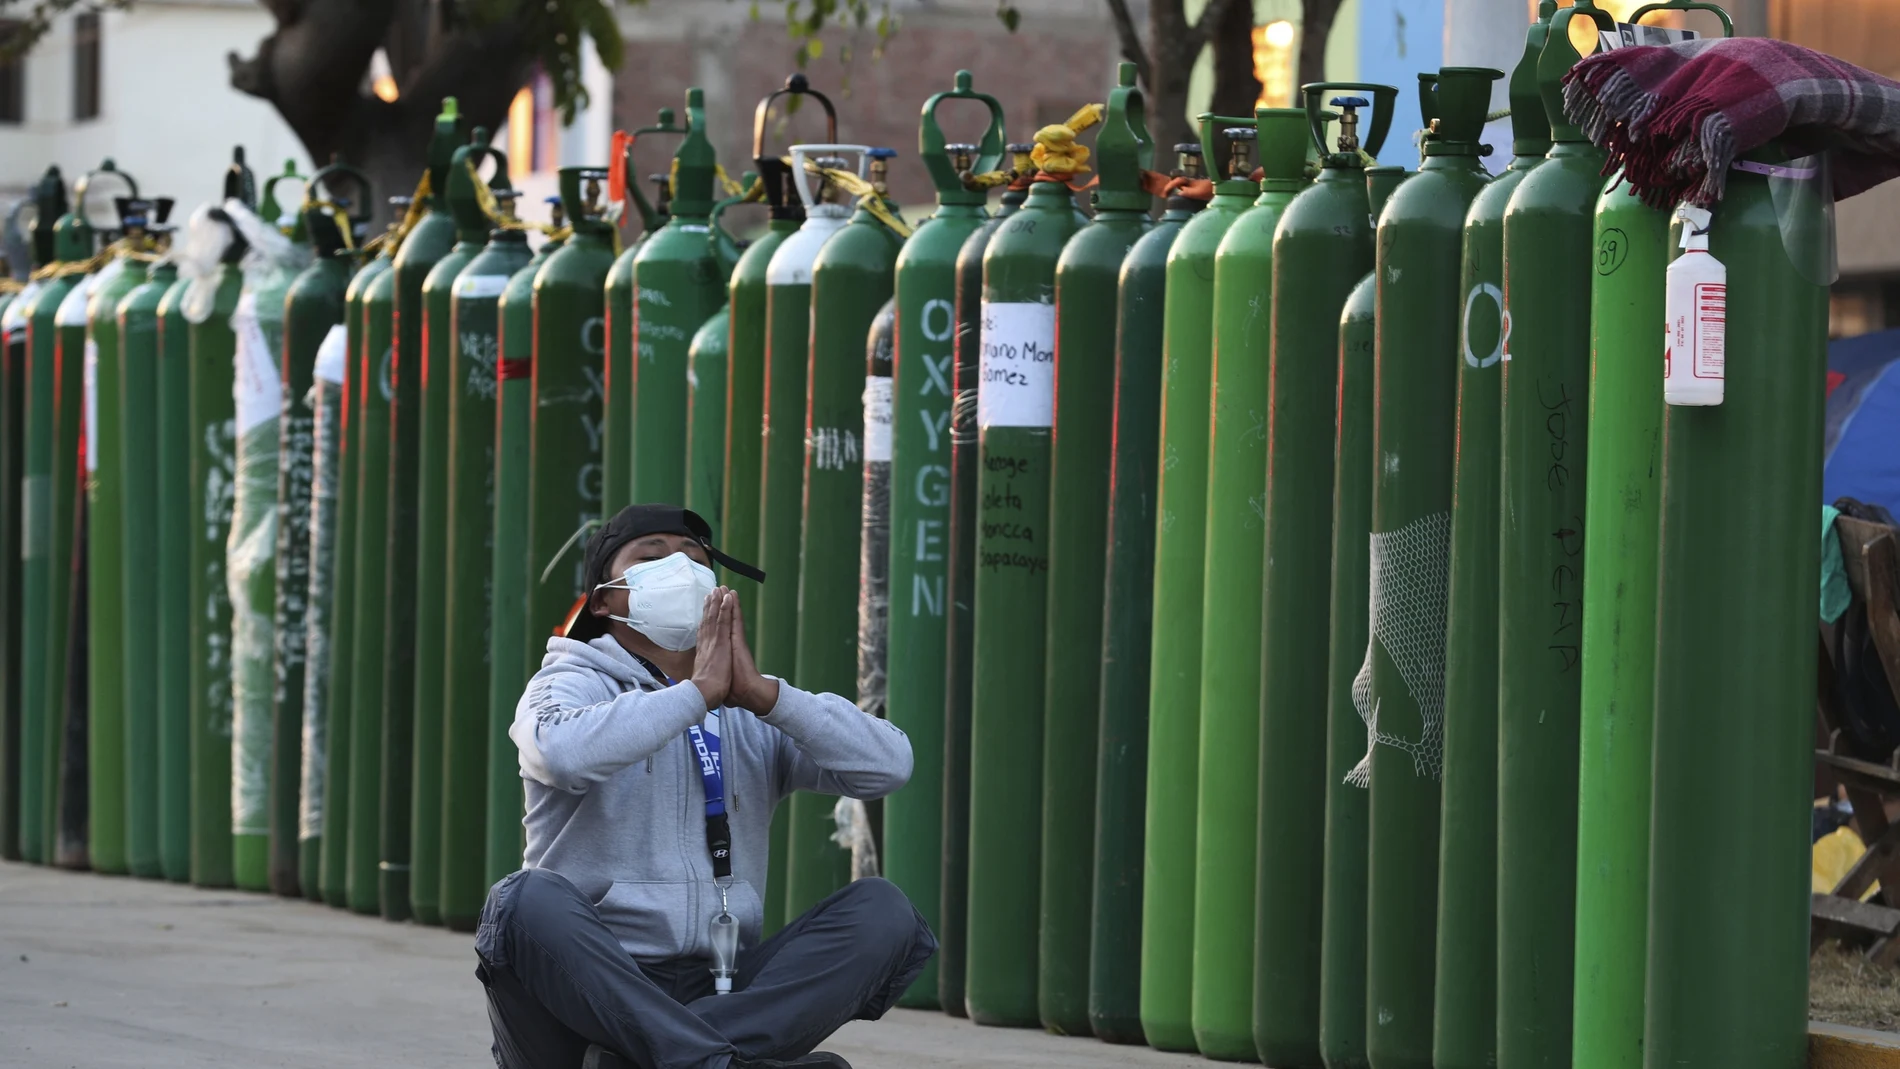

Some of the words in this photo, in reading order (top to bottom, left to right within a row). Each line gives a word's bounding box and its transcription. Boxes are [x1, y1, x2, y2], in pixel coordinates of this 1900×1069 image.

[1599, 239, 1618, 267] 69
[911, 298, 954, 618] OXYGEN
[688, 724, 716, 777] NDAI
